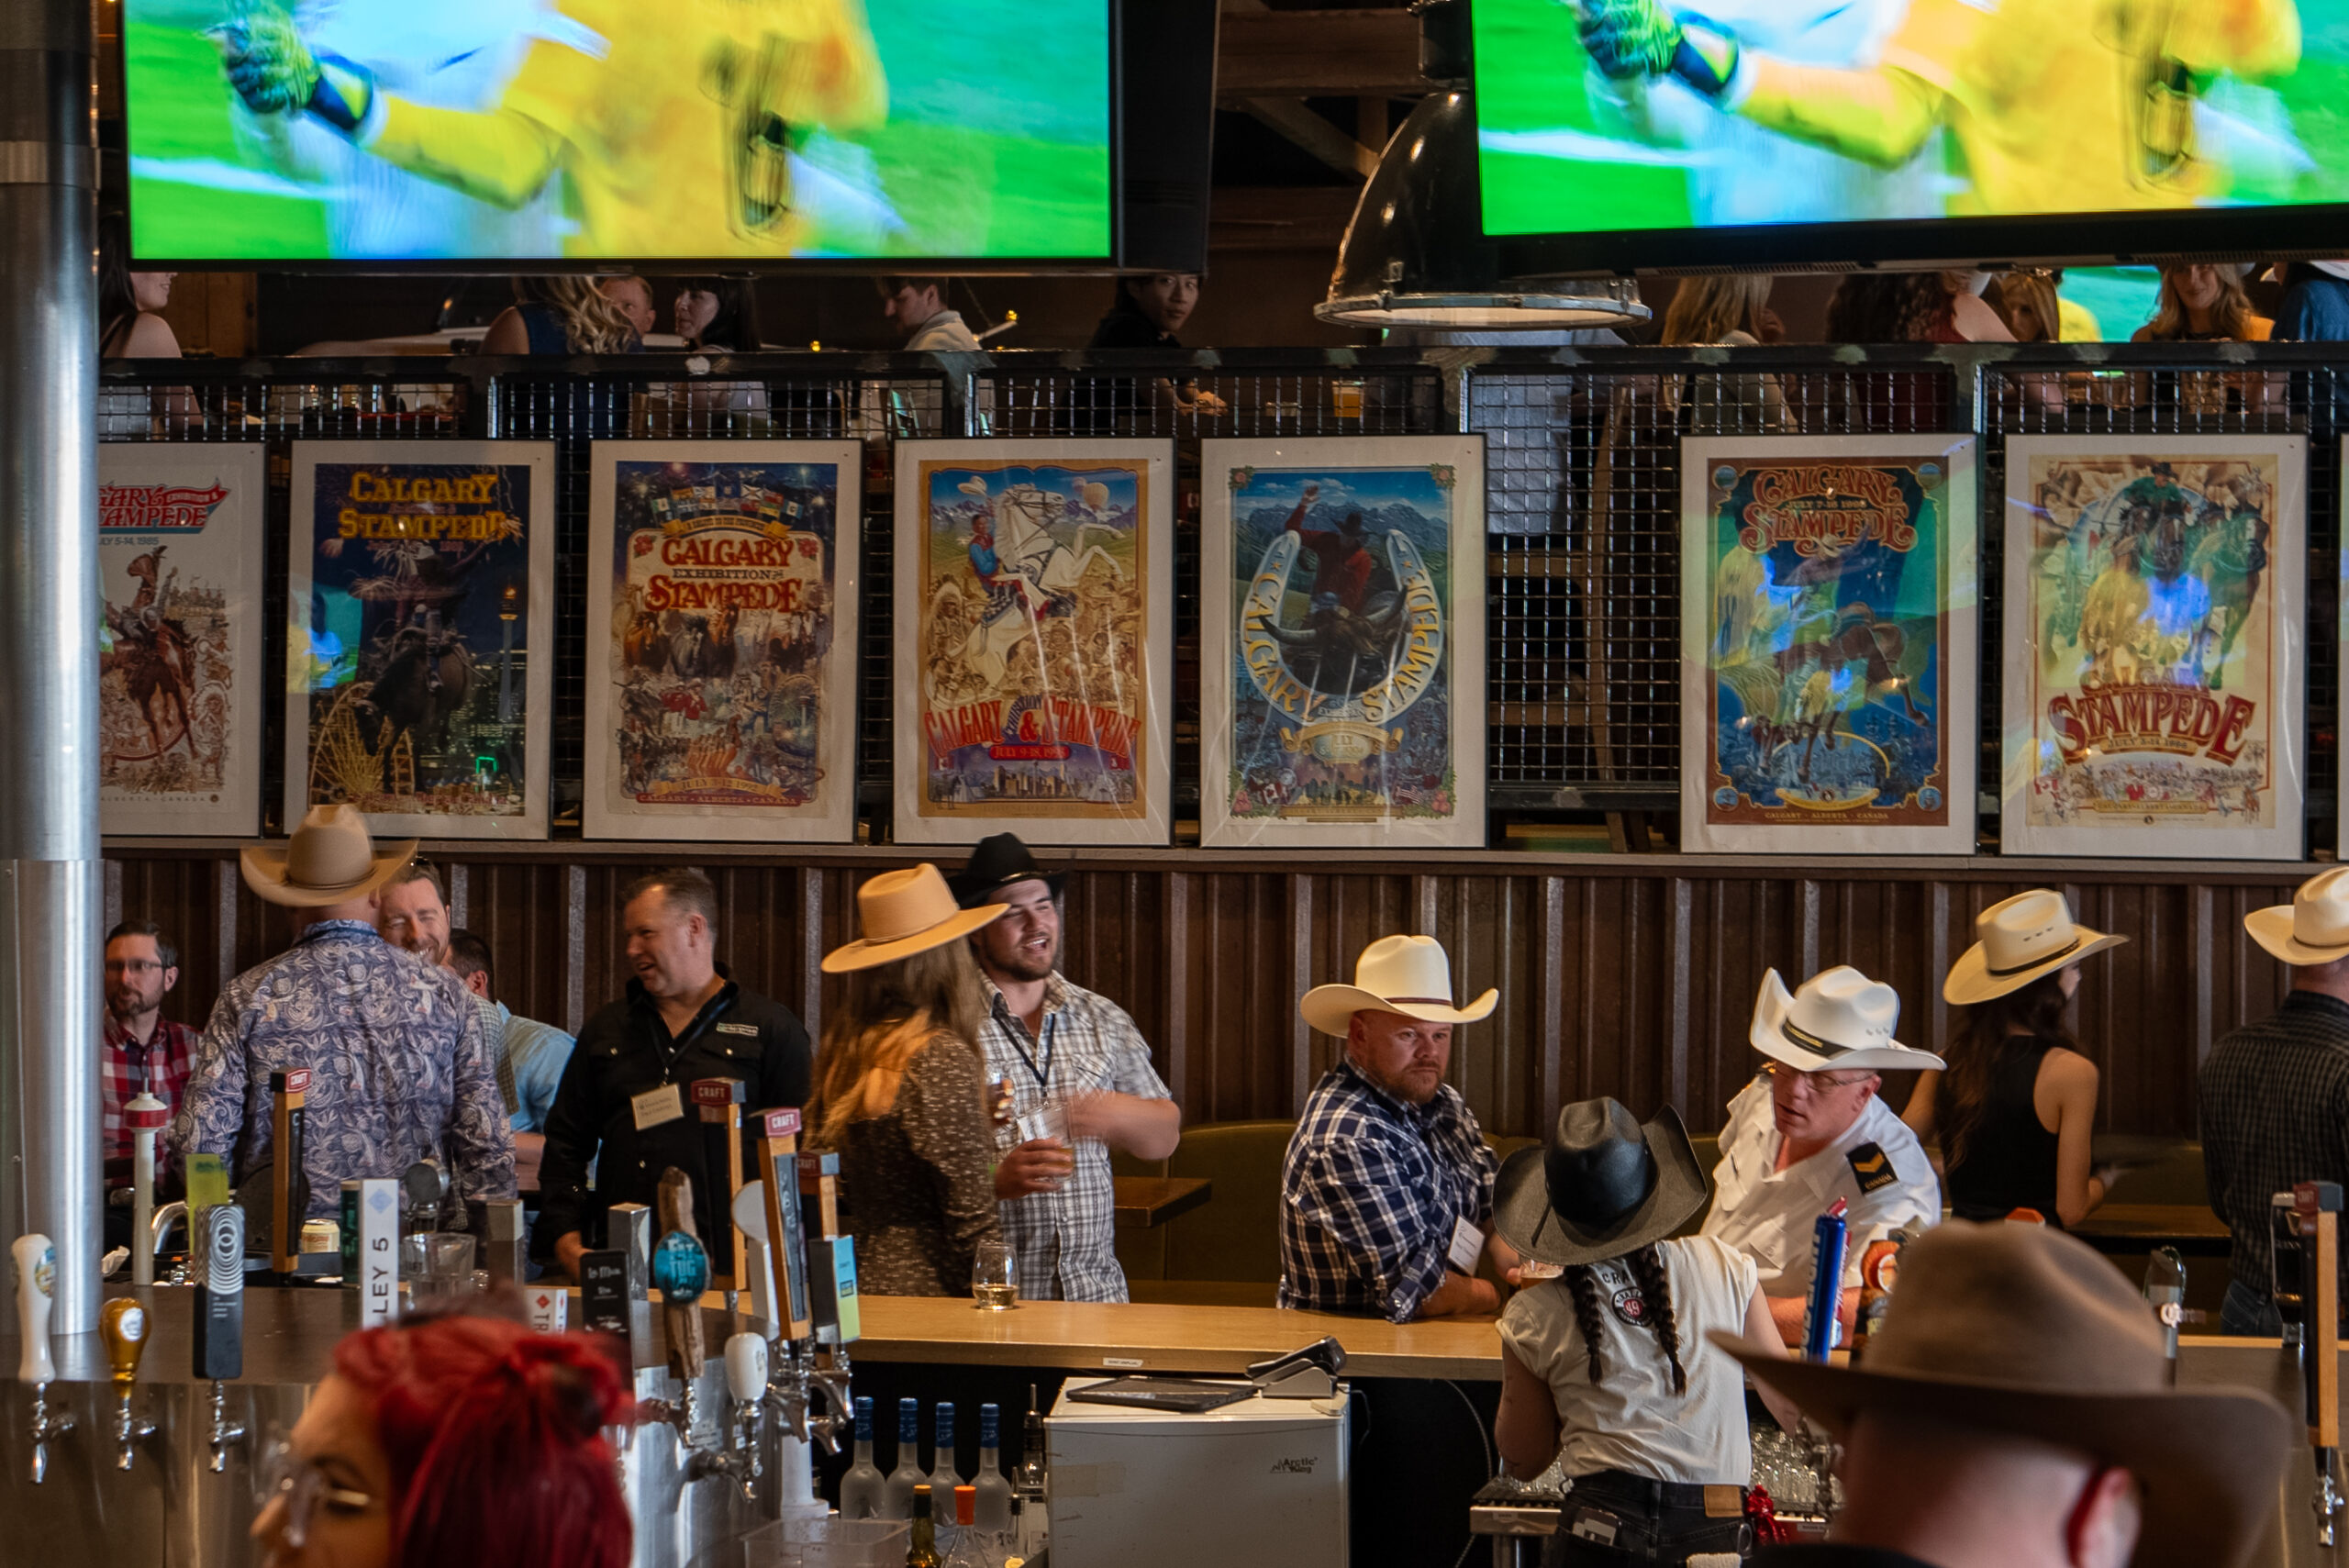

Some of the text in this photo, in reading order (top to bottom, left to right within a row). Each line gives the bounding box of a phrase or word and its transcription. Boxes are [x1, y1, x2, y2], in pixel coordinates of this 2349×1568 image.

[351, 472, 498, 504] CALGARY
[1753, 464, 1904, 506] CALGARY
[338, 507, 507, 540] STAMPEDE
[1740, 504, 1919, 556] STAMPEDE
[662, 538, 794, 566] CALGARY
[673, 569, 772, 579] EXHIBITION
[644, 574, 802, 613] STAMPEDE
[1244, 568, 1441, 722] CALGARY STAMPEDE
[924, 700, 1006, 759] CALGARY
[1019, 711, 1039, 742] &
[1041, 695, 1142, 759] STAMPEDE
[2047, 693, 2256, 767] STAMPEDE
[994, 747, 1016, 758] JULY
[698, 1087, 725, 1098] CRAFT
[772, 1113, 796, 1129] CRAFT
[373, 1237, 389, 1314] LEY 5
[669, 1261, 697, 1277] TUG
[1602, 1269, 1631, 1284] CRA
[1624, 1299, 1641, 1316] 49
[1284, 1457, 1315, 1466] Arctic
